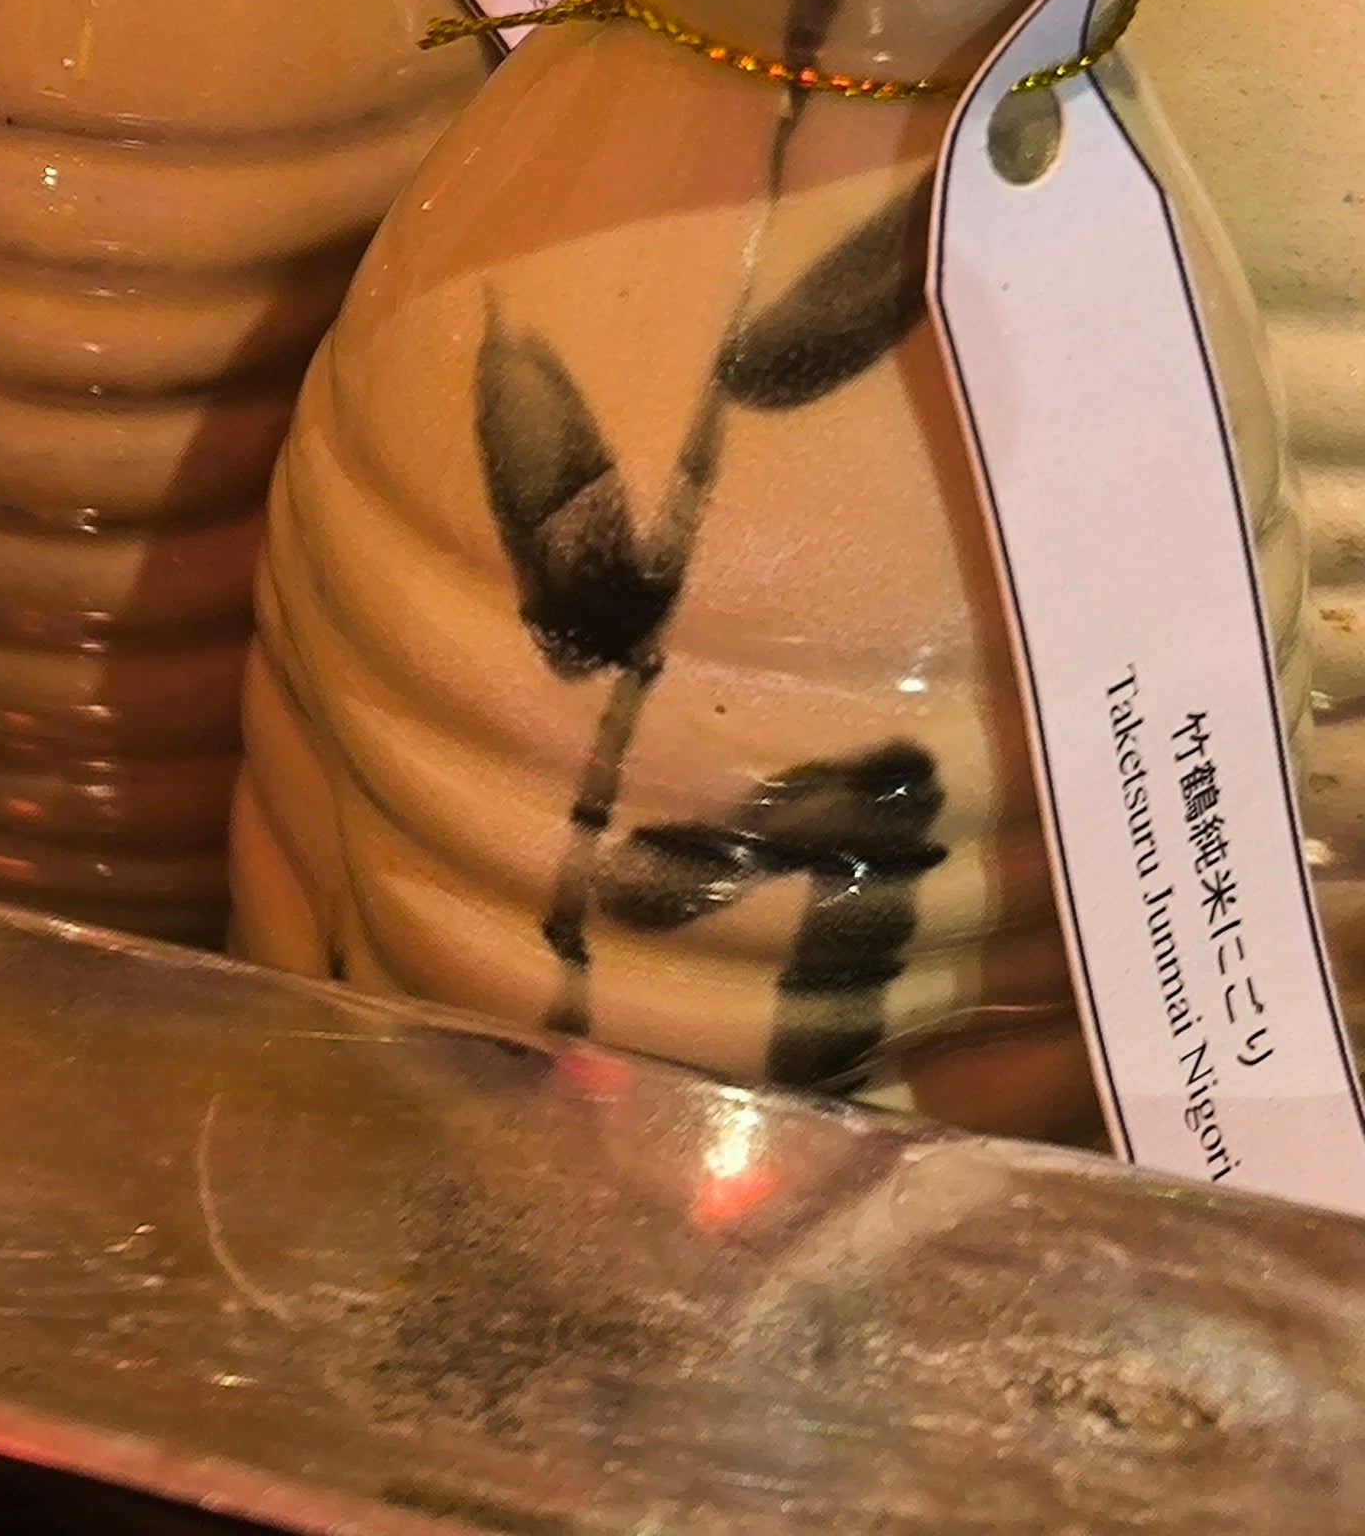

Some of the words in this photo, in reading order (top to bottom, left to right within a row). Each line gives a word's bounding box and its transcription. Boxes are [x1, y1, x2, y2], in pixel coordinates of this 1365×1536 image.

[1105, 663, 1162, 878] Taketsuru
[1142, 884, 1203, 1038] Junmai
[1178, 1040, 1242, 1183] Nigori
[1172, 710, 1274, 1067] 竹鶴純米にごり
